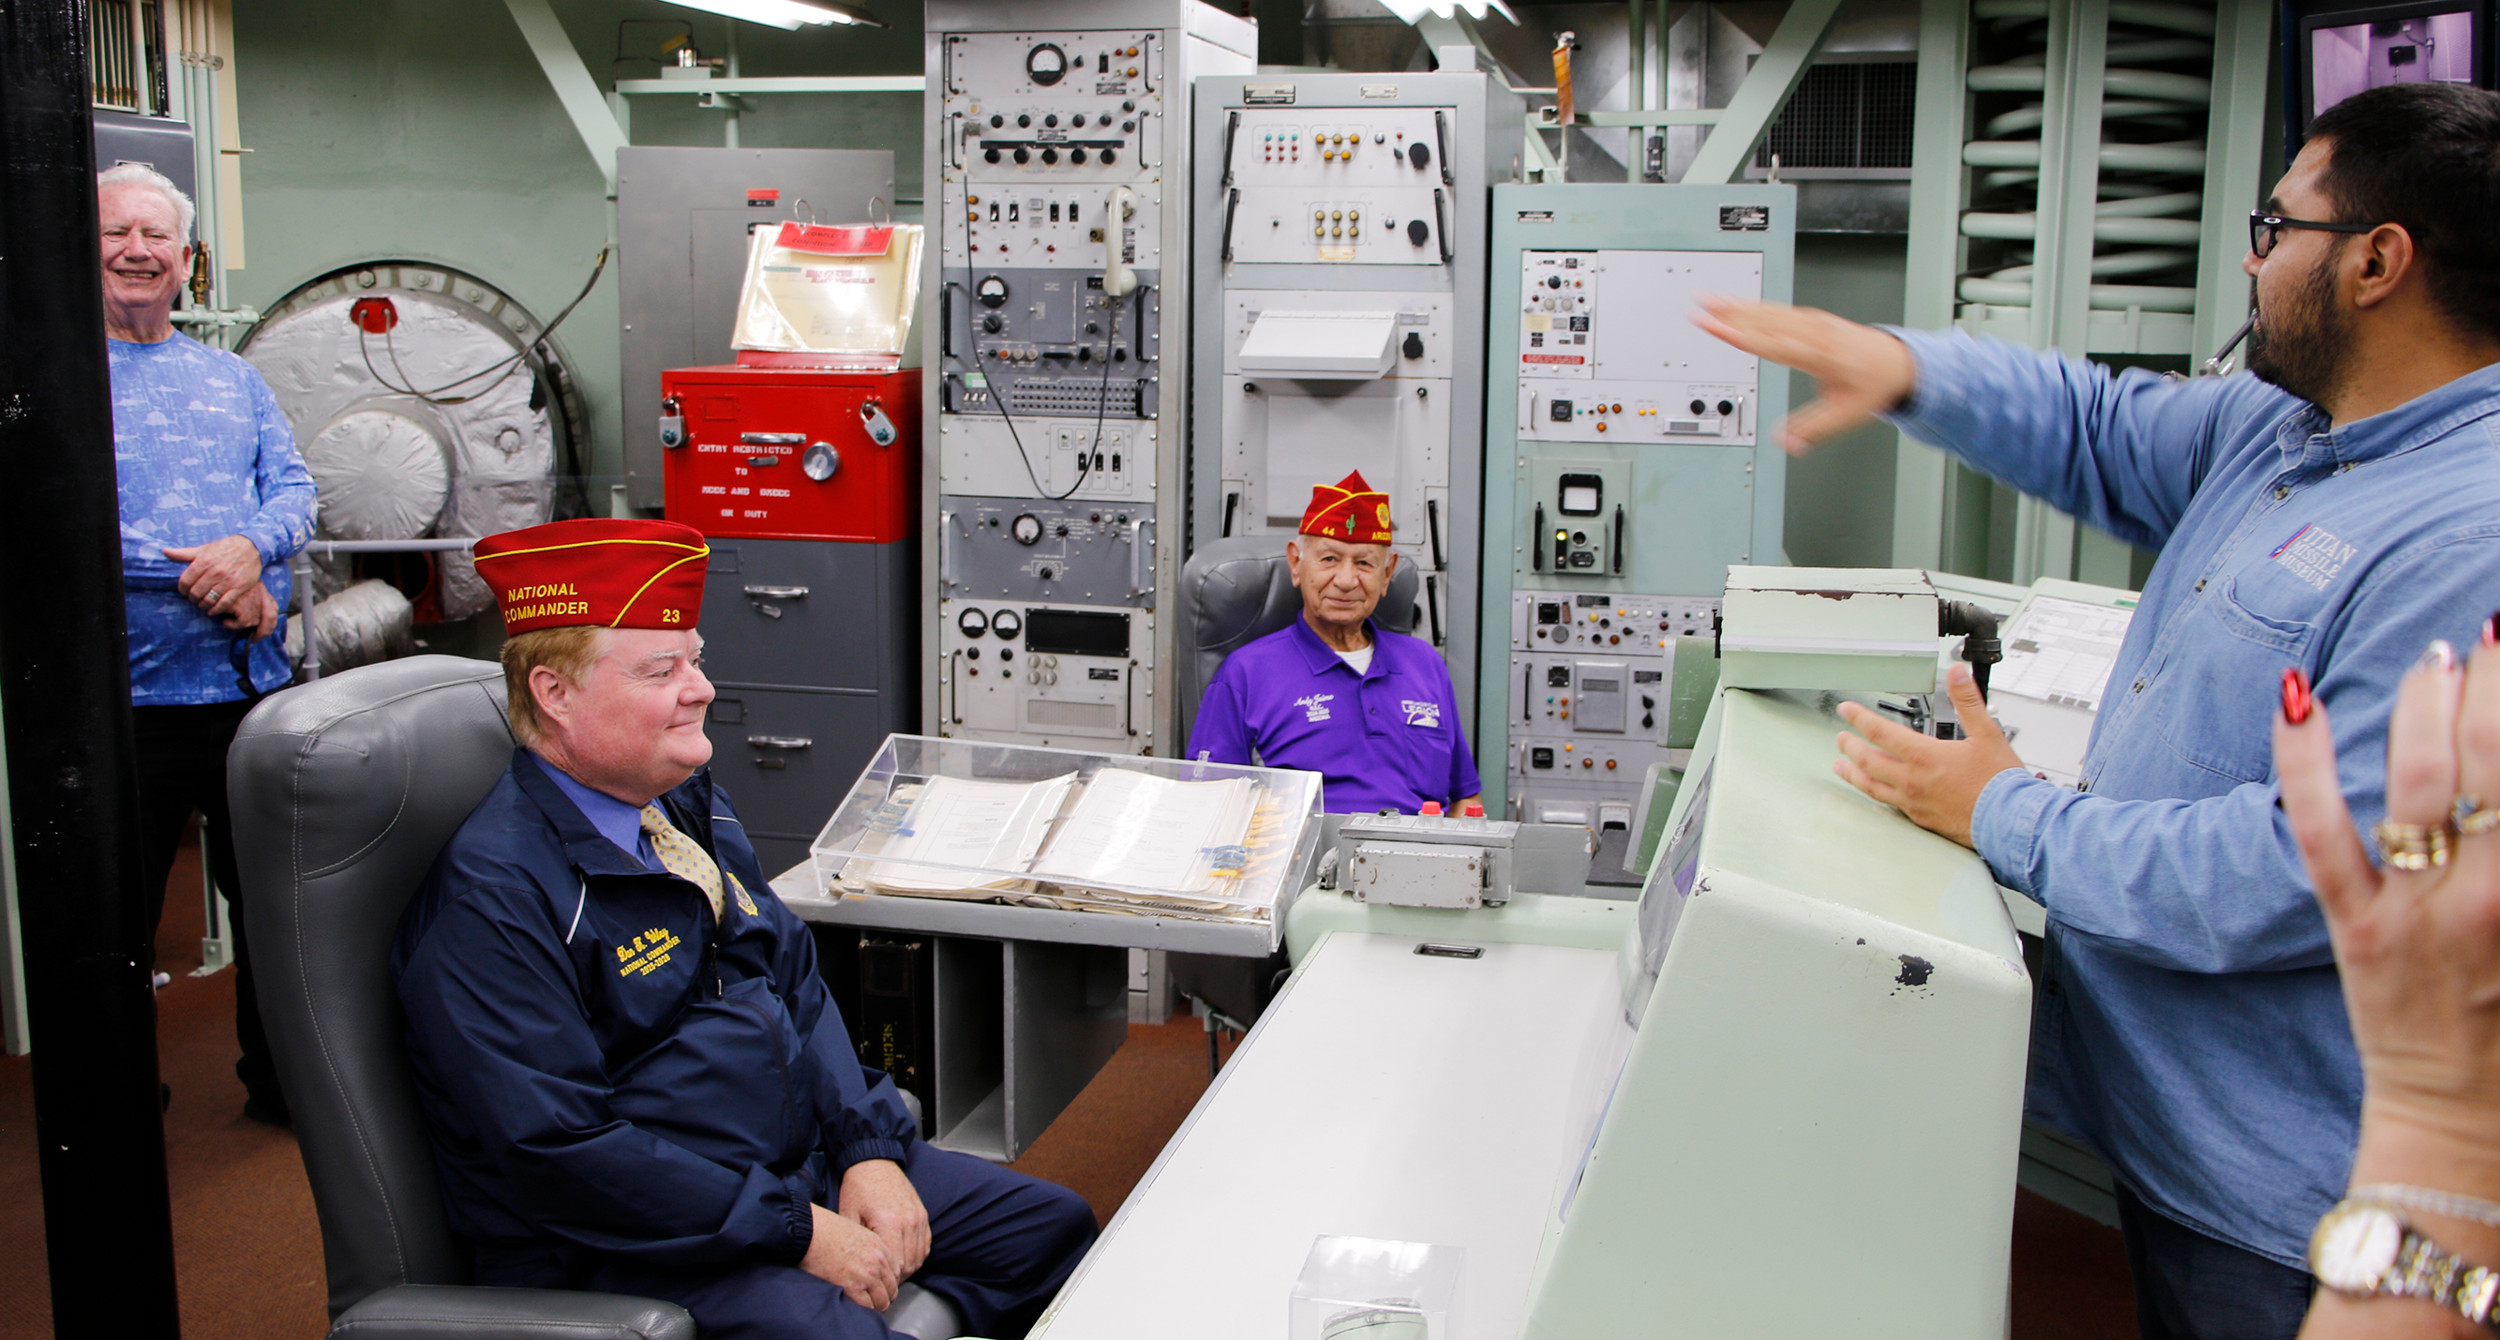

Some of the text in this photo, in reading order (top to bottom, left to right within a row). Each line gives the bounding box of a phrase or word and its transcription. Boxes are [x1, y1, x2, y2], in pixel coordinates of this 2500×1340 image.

[697, 444, 793, 455] ENTRY RESTRICTED
[735, 467, 748, 476] TO
[731, 487, 750, 496] AND
[721, 509, 768, 519] ON DUTY
[1322, 526, 1335, 536] 44
[2302, 526, 2360, 565] TITAN
[2287, 540, 2343, 579] MISSILE
[2276, 552, 2333, 592] MUSEUM
[508, 582, 579, 603] NATIONAL
[505, 601, 589, 624] COMMANDER
[662, 608, 681, 624] 23
[619, 936, 681, 977] NATIONAL COMMANDER
